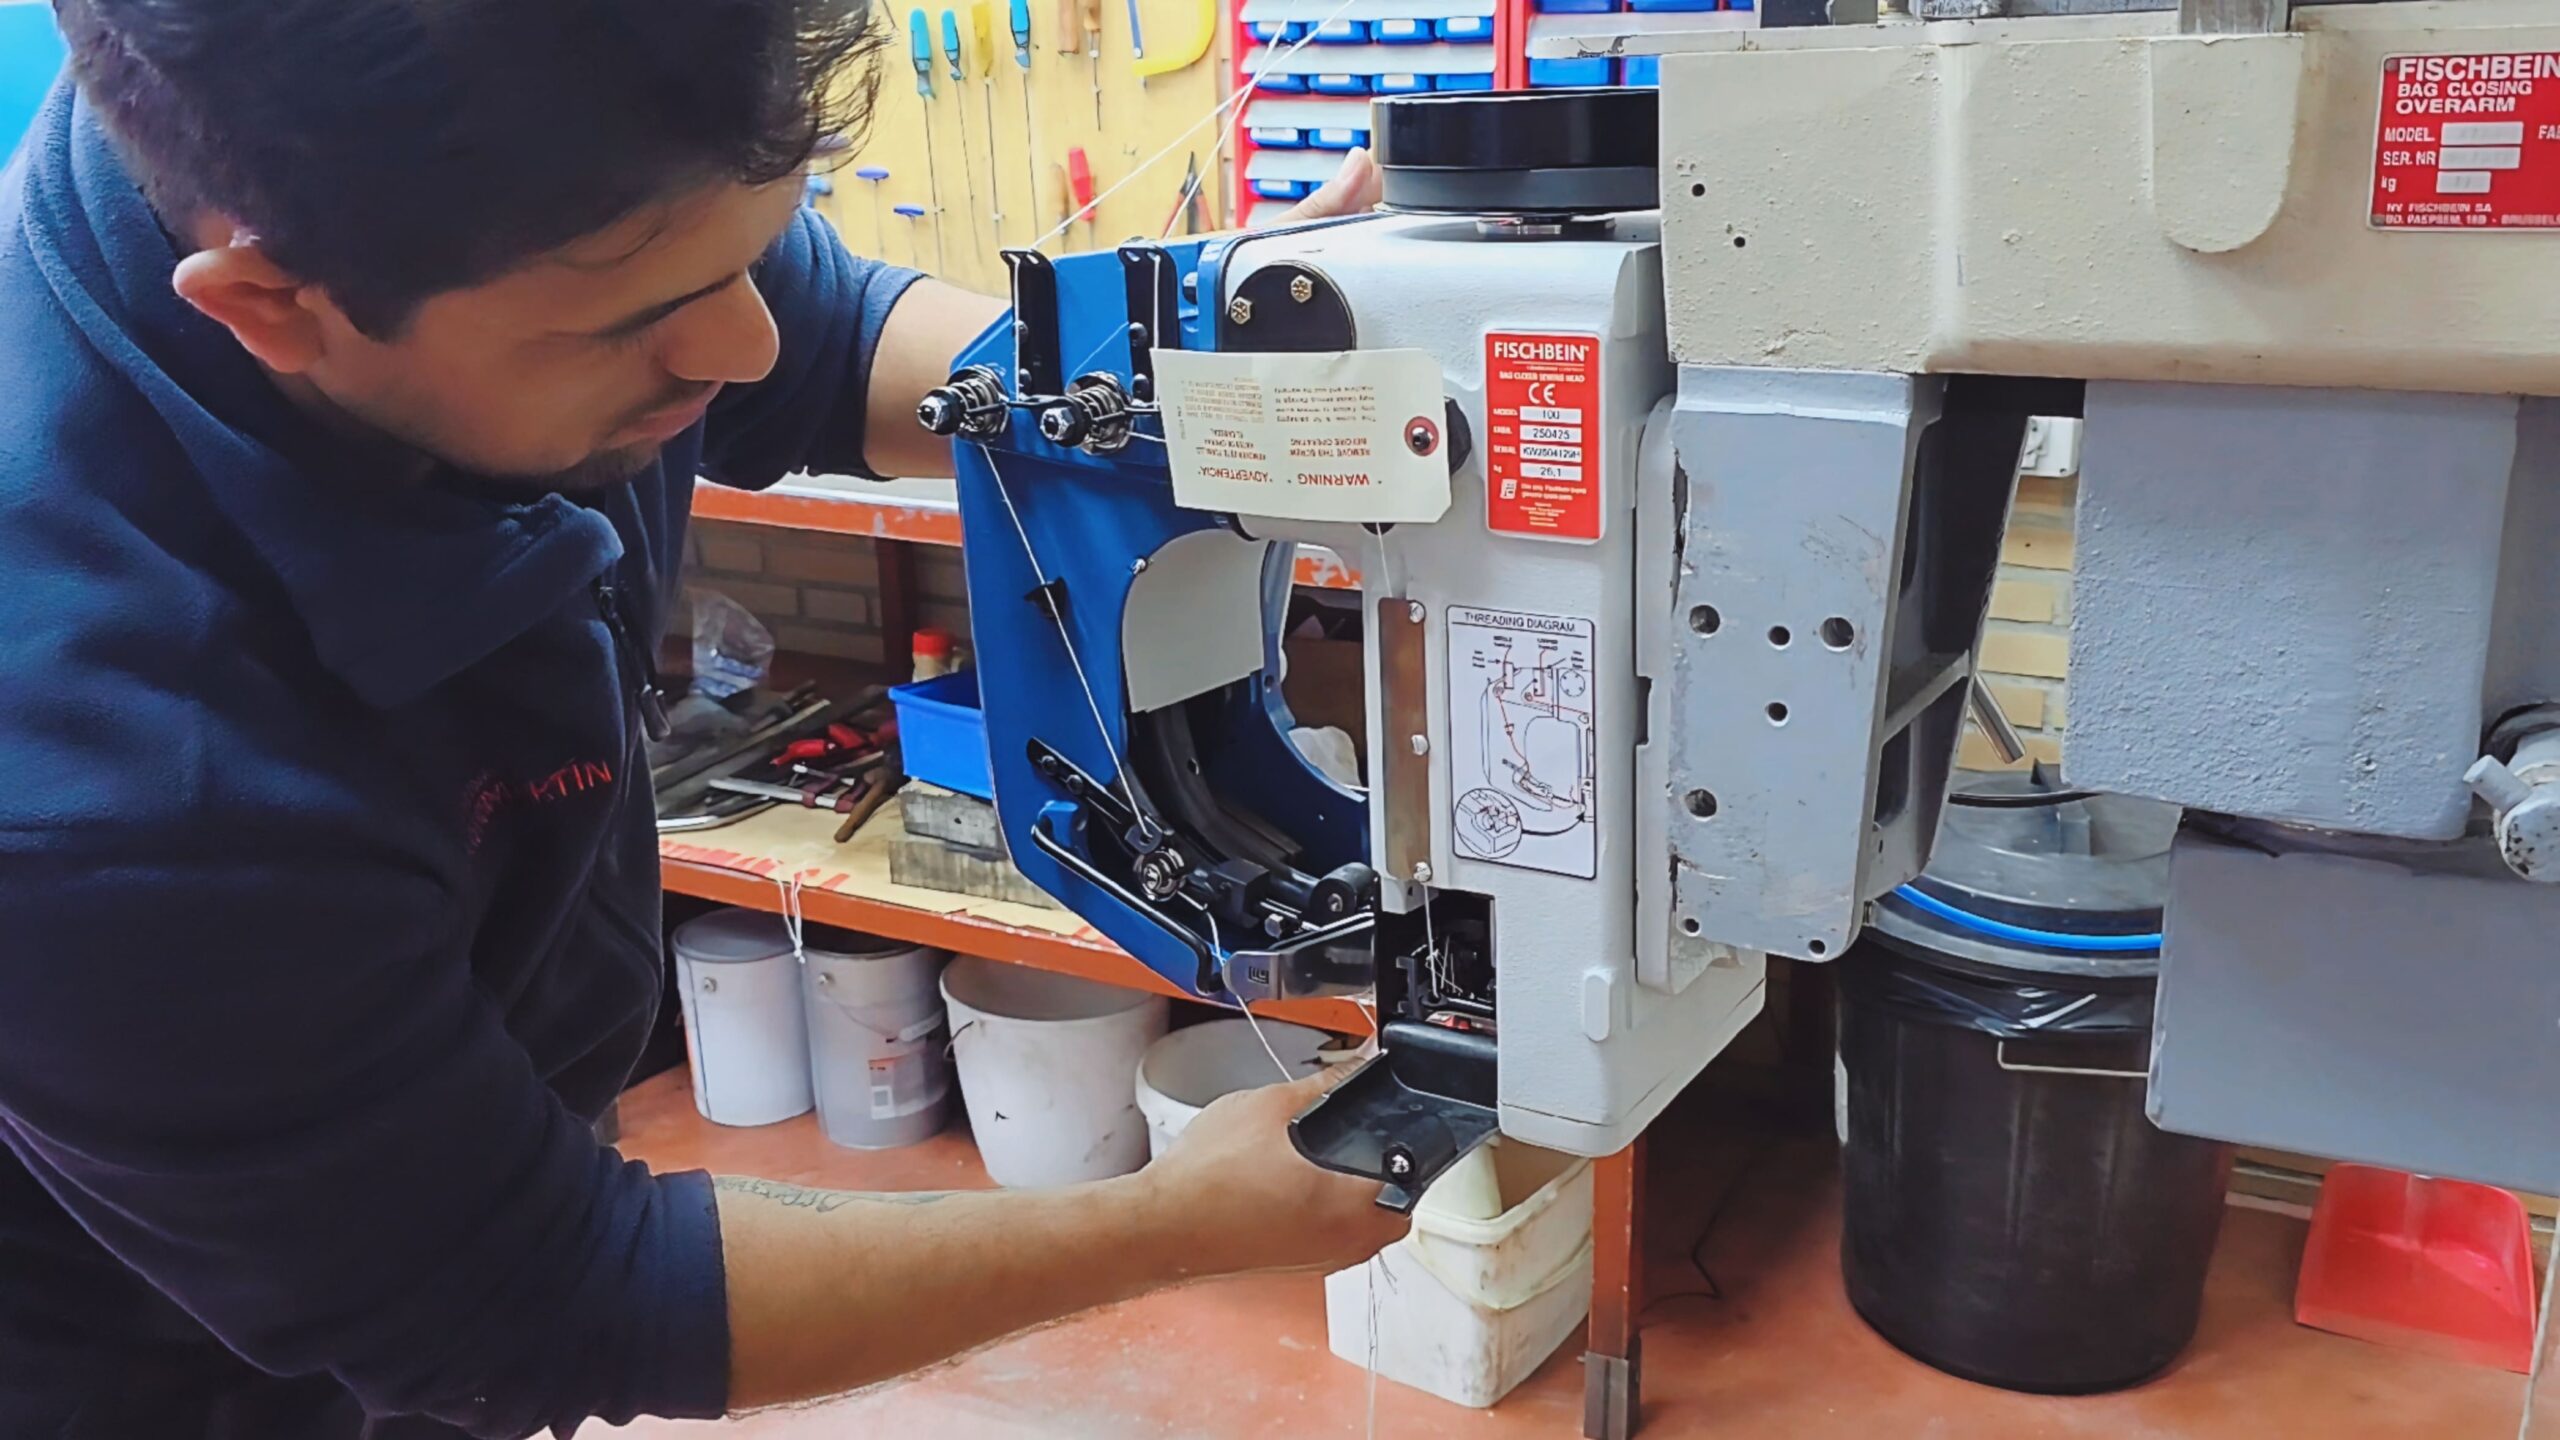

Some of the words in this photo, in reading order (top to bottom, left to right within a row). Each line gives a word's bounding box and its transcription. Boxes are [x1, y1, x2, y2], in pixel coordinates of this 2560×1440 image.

[2398, 55, 2560, 81] FISCHBEIN
[2397, 83, 2439, 97] BAG
[2447, 80, 2533, 97] CLOSING
[2395, 97, 2516, 115] OVERARM
[2416, 151, 2437, 165] NR
[1542, 409, 1560, 420] 100
[1532, 428, 1570, 440] 250425
[1200, 466, 1269, 482] ADVERTENCIA
[1297, 473, 1370, 486] WARNING
[1464, 611, 1524, 628] THREADING
[1526, 618, 1575, 632] DIAGRAM
